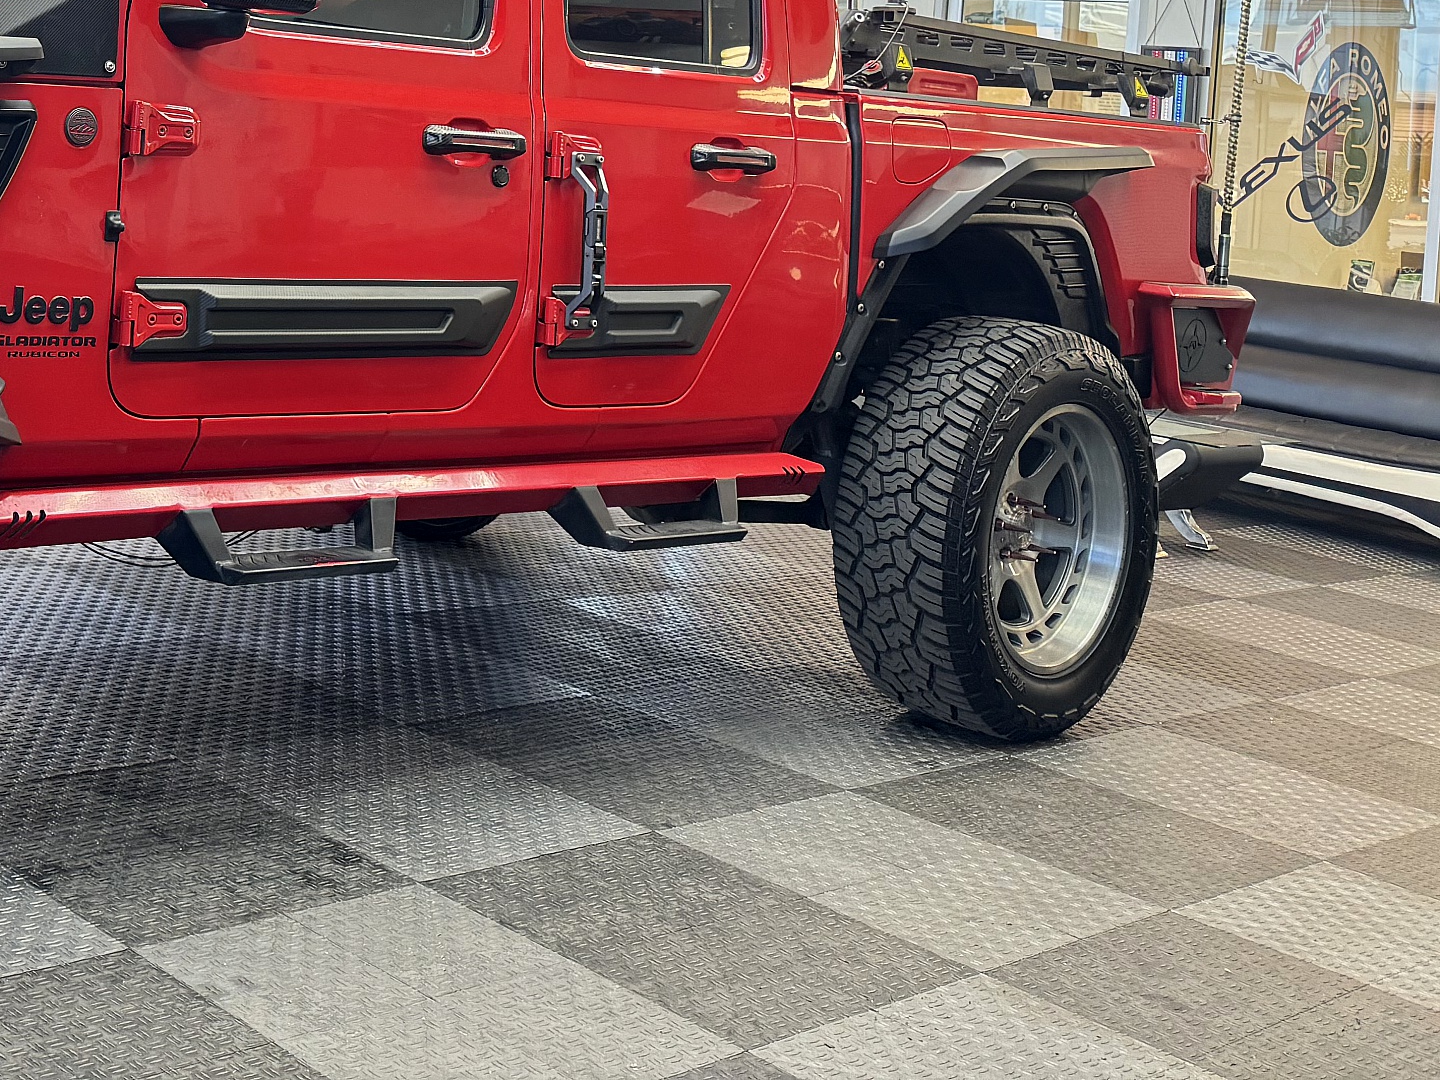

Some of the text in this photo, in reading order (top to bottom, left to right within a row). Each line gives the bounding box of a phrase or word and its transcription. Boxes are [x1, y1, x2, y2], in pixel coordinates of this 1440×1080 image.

[1348, 48, 1389, 150] ROMEO
[7, 350, 81, 359] RUBICON
[1080, 377, 1149, 484] GEOLANDAR
